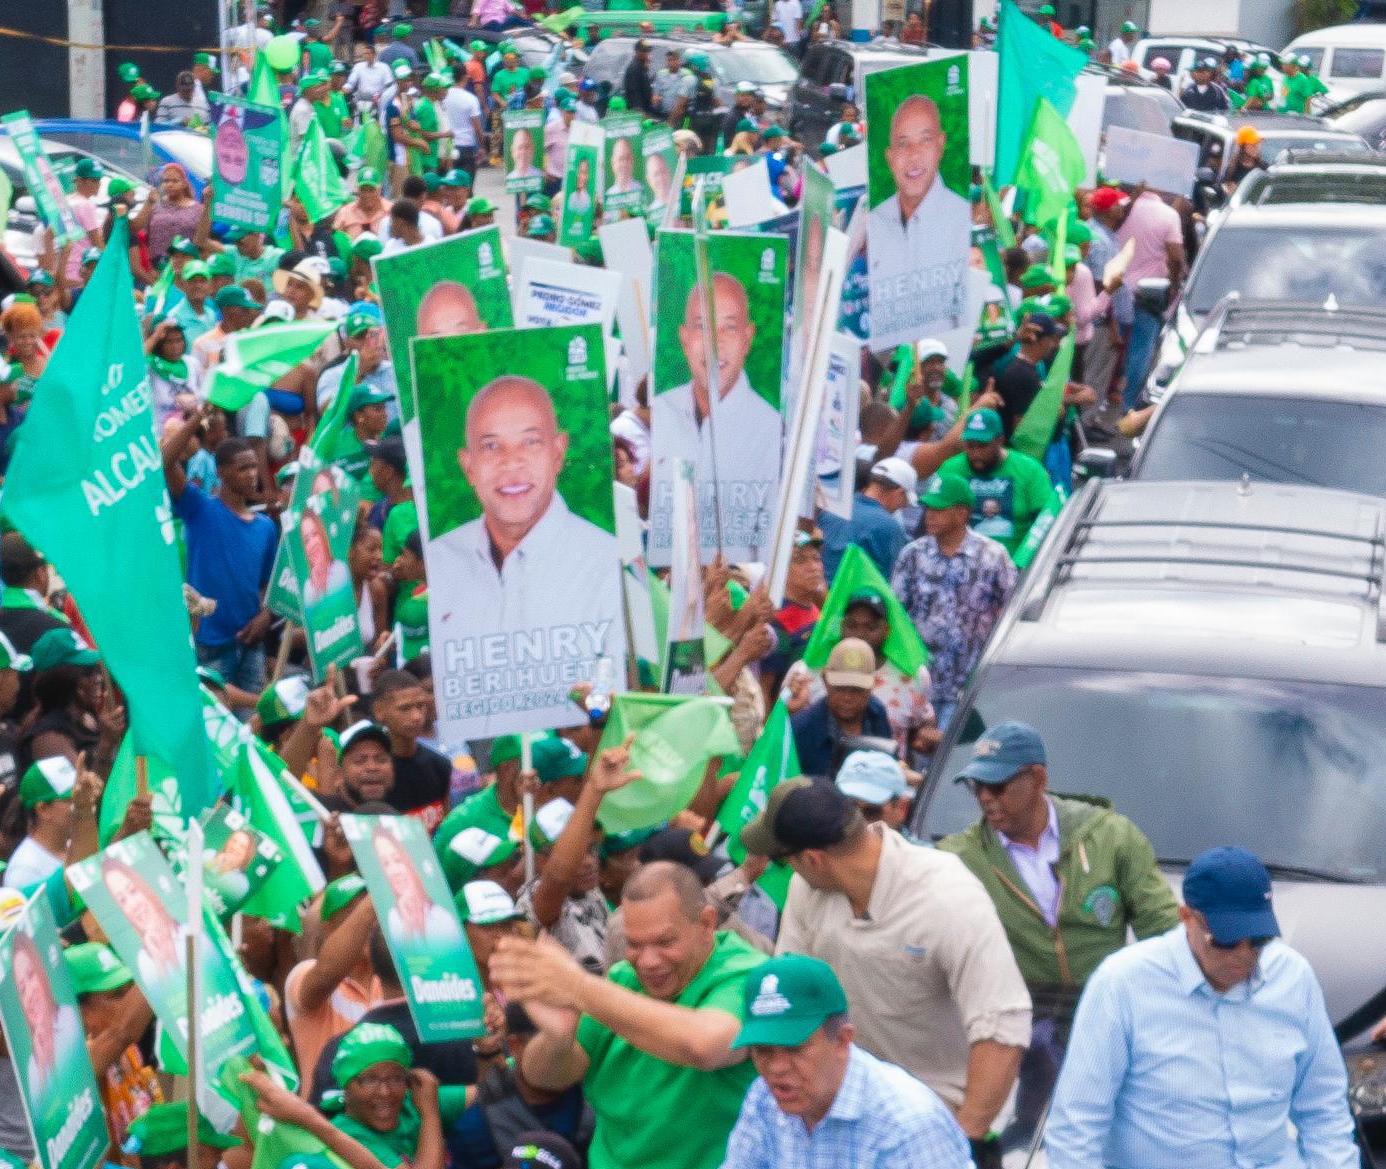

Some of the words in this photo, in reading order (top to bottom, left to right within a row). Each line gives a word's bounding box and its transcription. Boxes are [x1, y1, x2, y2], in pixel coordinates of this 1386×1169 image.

[531, 289, 563, 306] PEDRO
[542, 302, 589, 318] REGIDOR
[444, 619, 613, 674] HENRY
[444, 659, 598, 700] BERIHUET
[410, 971, 479, 1005] Danaides
